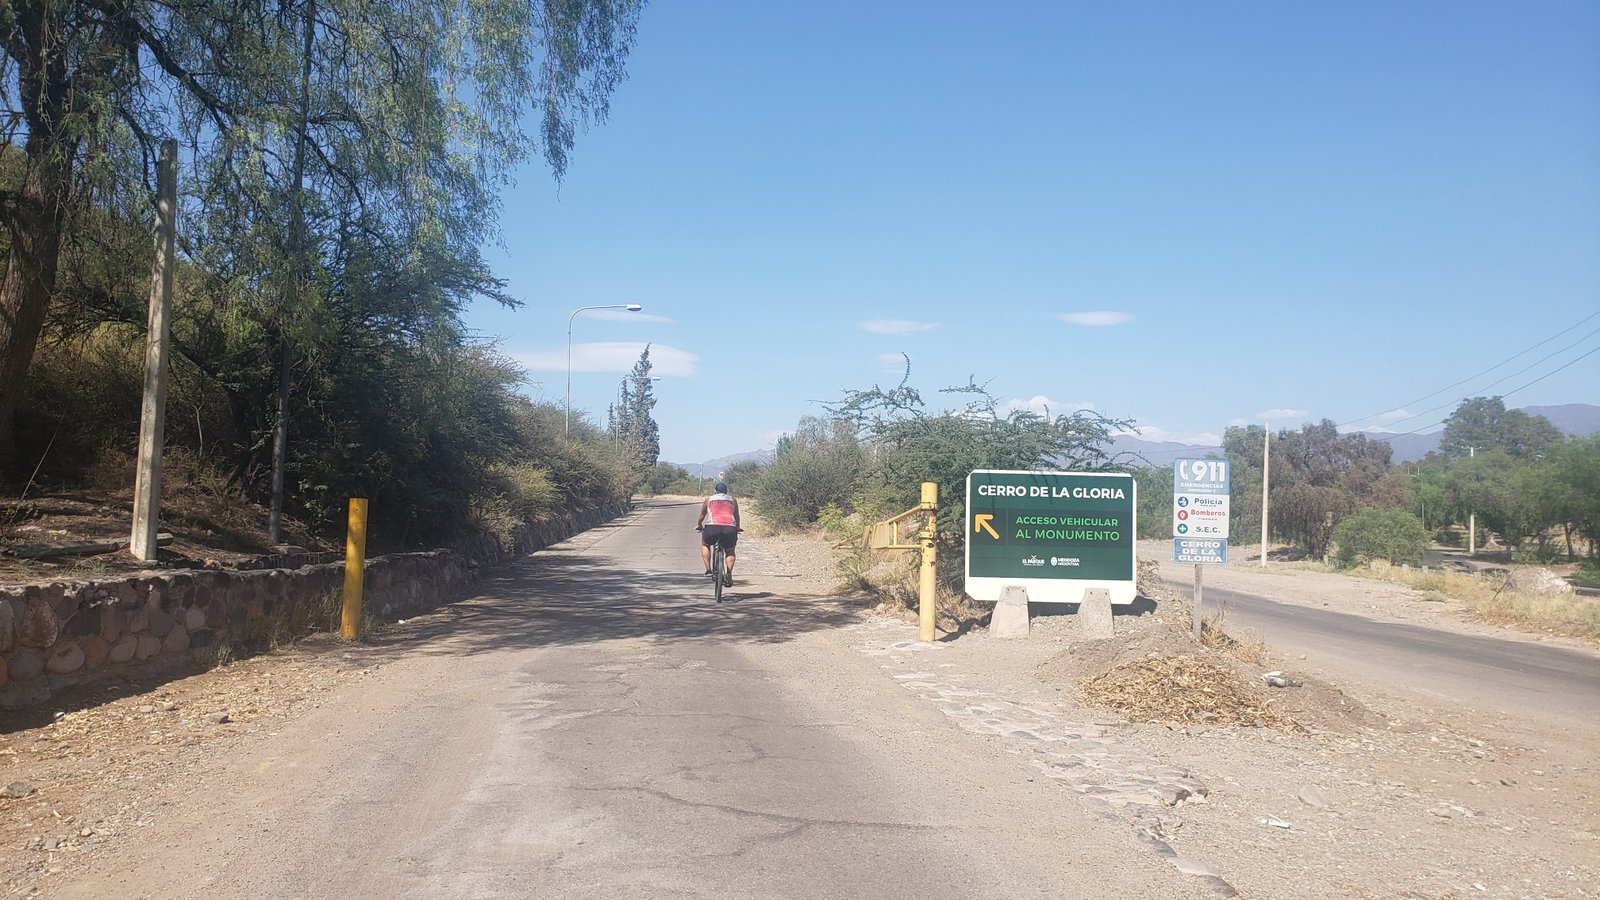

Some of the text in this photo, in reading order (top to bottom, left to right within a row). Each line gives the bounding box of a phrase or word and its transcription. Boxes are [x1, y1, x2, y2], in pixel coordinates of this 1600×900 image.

[1192, 461, 1226, 482] 911
[978, 485, 1125, 499] CERRO DE LA GLORIA
[1191, 509, 1226, 517] Bomberos
[1016, 516, 1118, 527] ACCESO VEHICULAR
[1015, 529, 1120, 541] AL MONUMENTO
